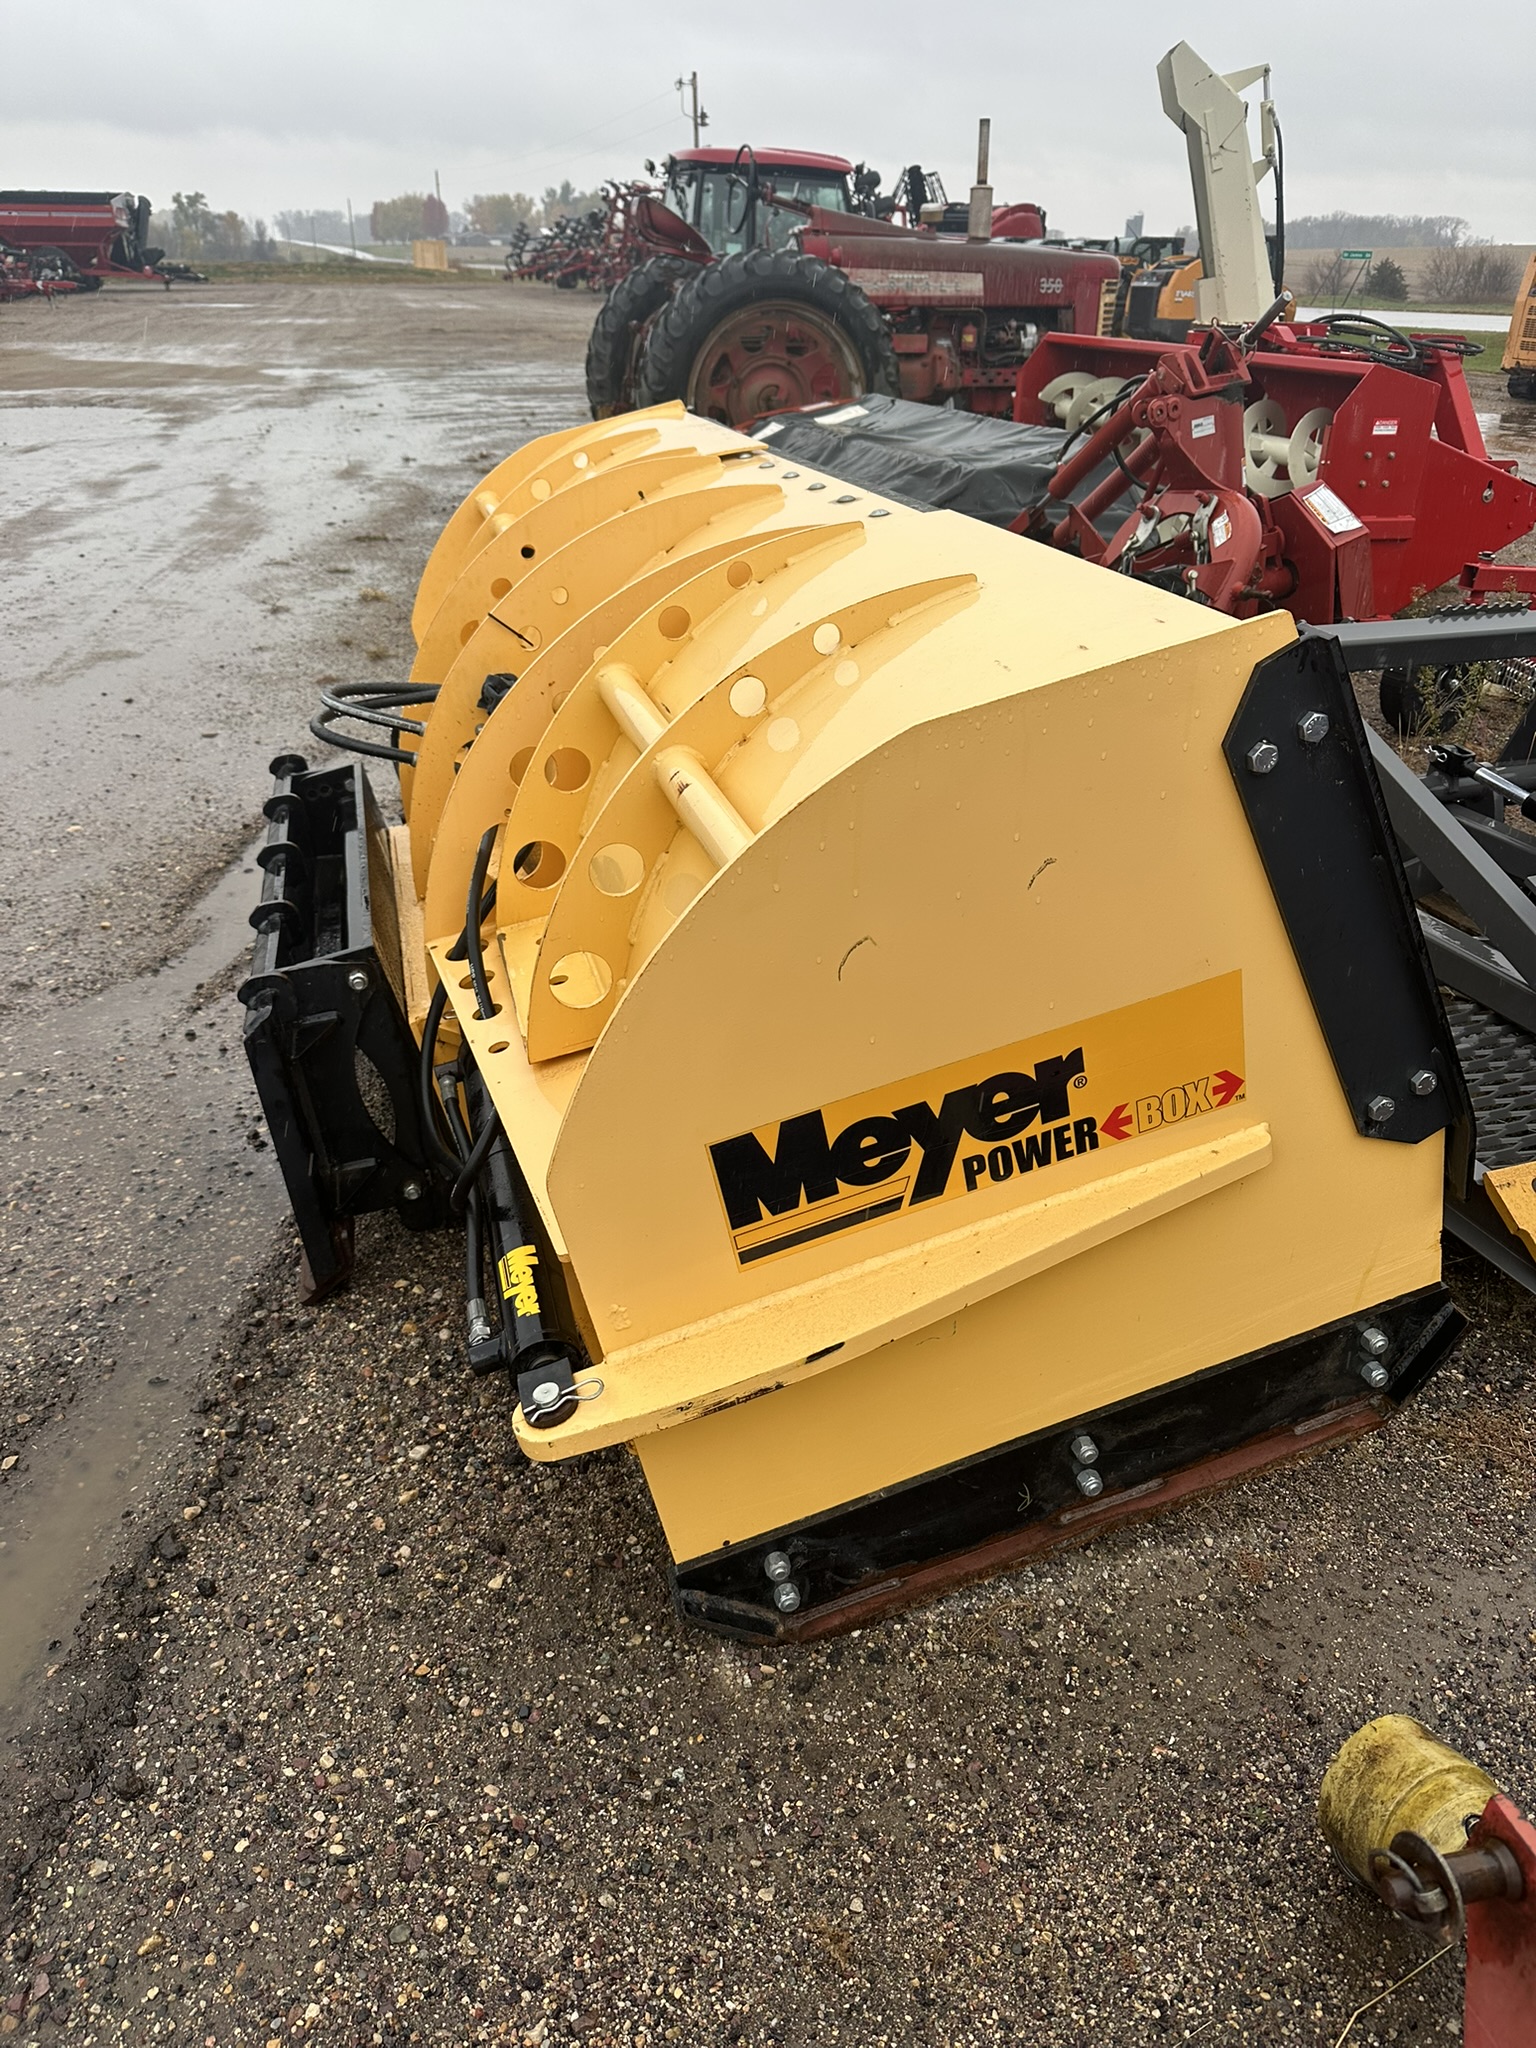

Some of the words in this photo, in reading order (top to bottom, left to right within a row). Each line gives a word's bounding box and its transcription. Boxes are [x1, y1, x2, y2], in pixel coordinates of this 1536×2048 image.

[1040, 277, 1064, 294] 350
[962, 1116, 1099, 1193] POWER
[1135, 1076, 1213, 1134] BOX
[503, 1244, 541, 1318] Meyer
